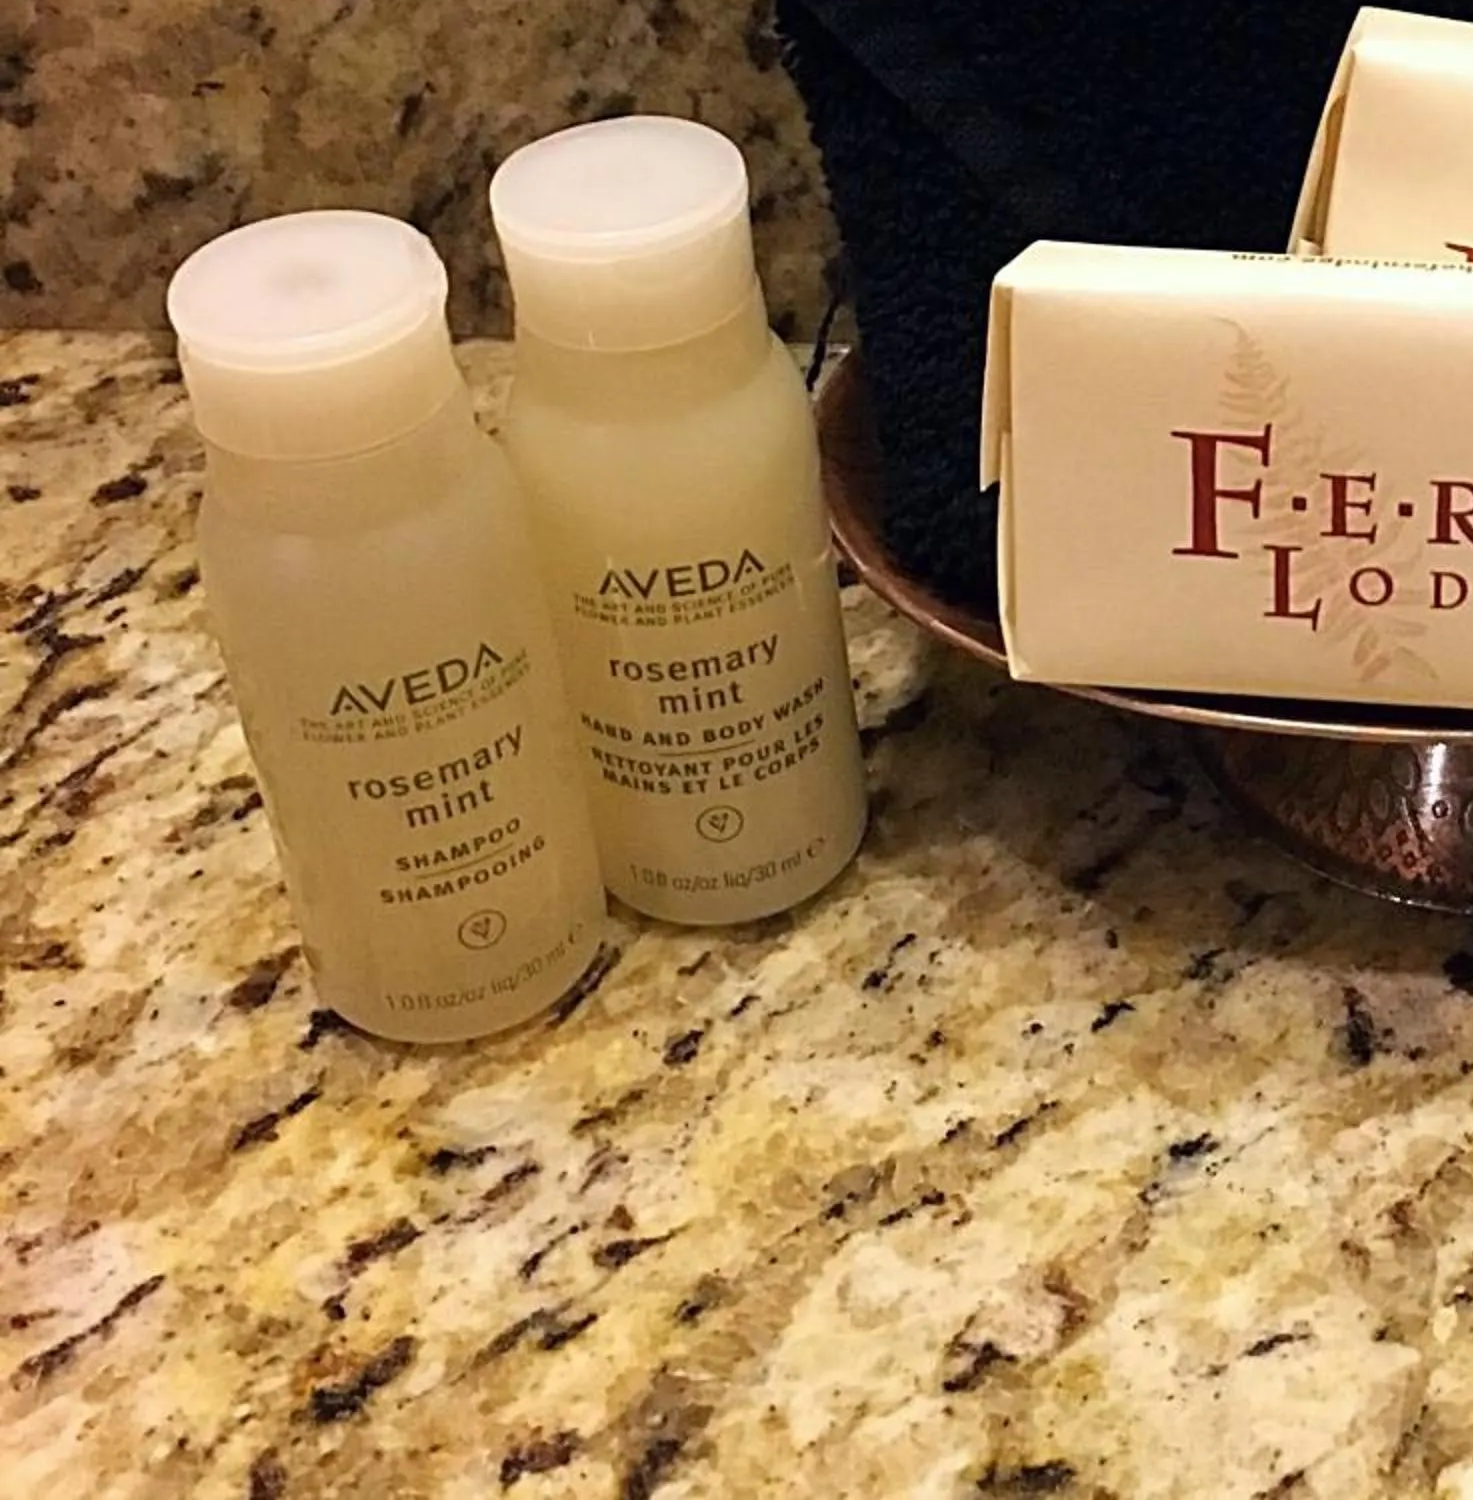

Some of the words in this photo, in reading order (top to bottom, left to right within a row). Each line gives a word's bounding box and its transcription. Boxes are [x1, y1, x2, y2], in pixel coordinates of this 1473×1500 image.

[598, 549, 764, 600] AVEDA
[635, 603, 667, 614] AND
[635, 616, 668, 627] AND
[673, 605, 722, 625] PLANT
[329, 642, 503, 716] AVEDA
[609, 634, 779, 683] rosemary
[581, 711, 633, 742] HAND
[642, 731, 691, 747] AND
[703, 714, 764, 744] BODY
[773, 677, 824, 722] WASH
[658, 681, 745, 715] mint
[374, 725, 409, 740] AND
[591, 746, 711, 777] NETTOYANT
[722, 739, 785, 772] POUR
[794, 713, 823, 744] LES
[347, 724, 522, 800] rosemary
[602, 766, 671, 795] MAINS
[682, 779, 707, 795] ET
[719, 773, 744, 791] LE
[753, 736, 820, 781] CORPS
[406, 779, 494, 828] mint
[380, 835, 546, 904] SHAMPOOING
[395, 816, 521, 872] SHAMPOO
